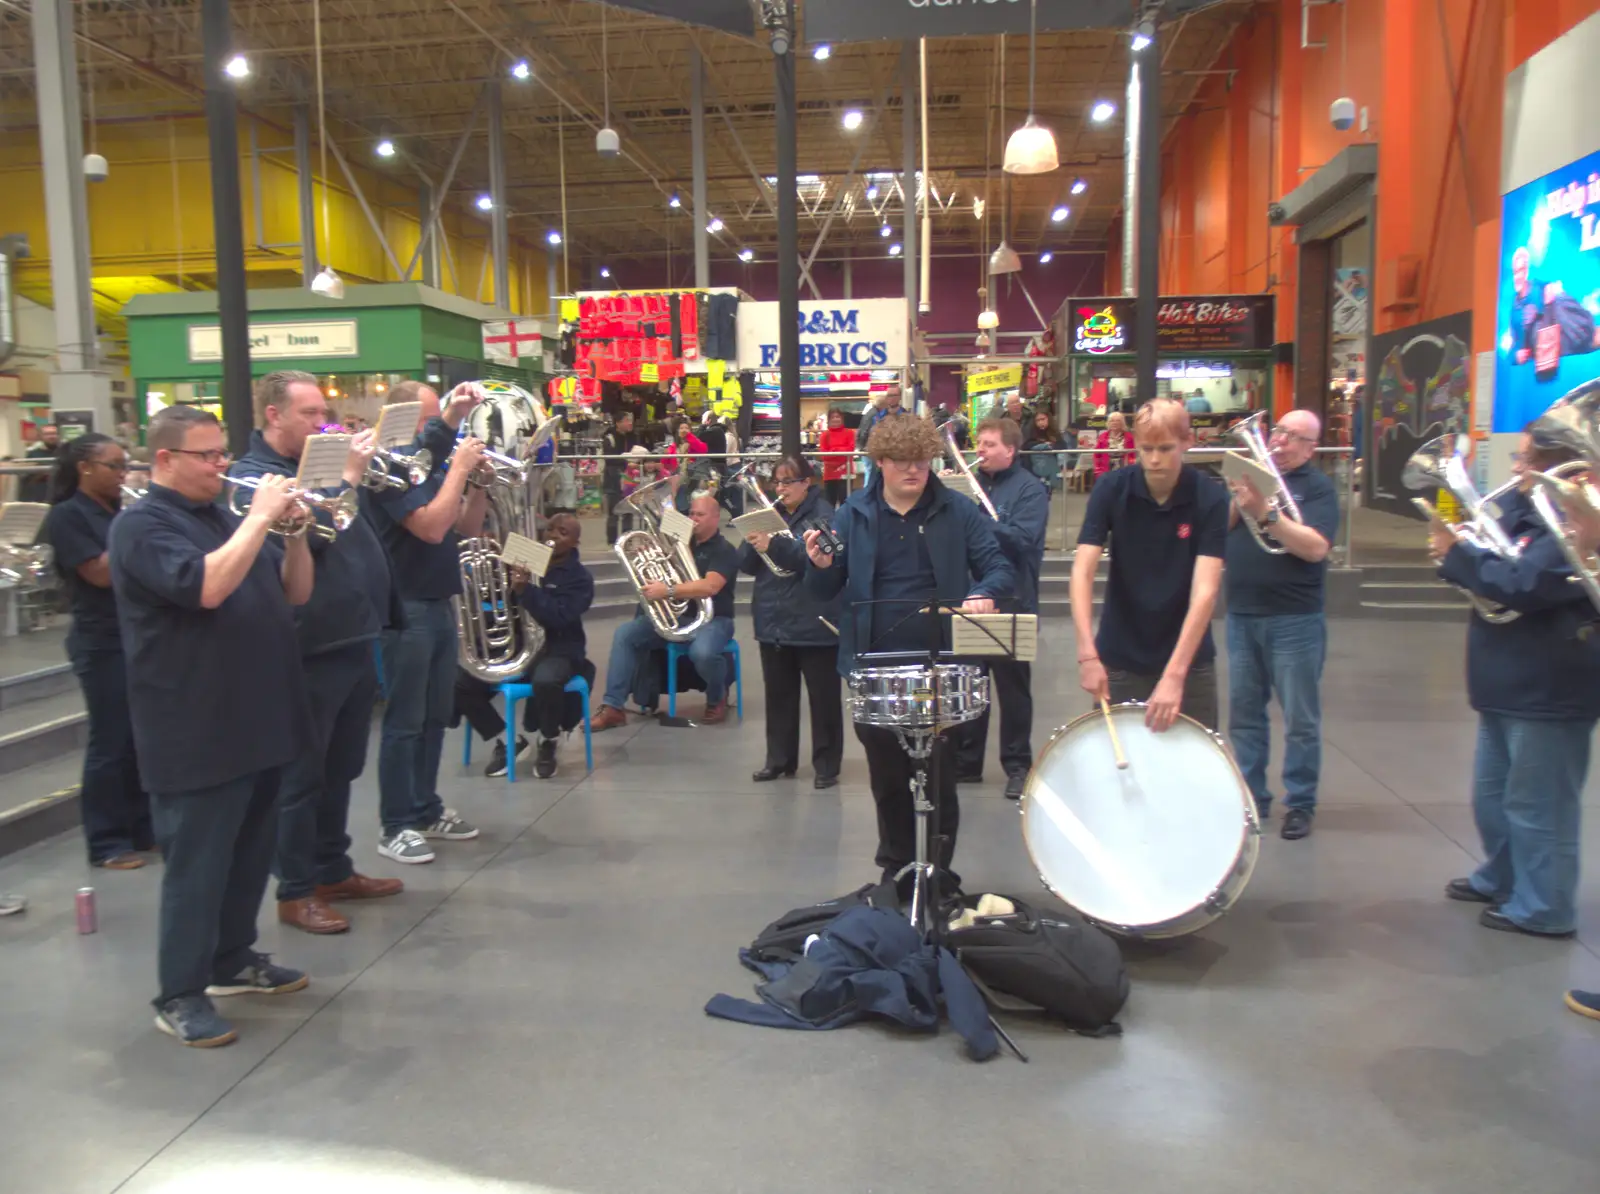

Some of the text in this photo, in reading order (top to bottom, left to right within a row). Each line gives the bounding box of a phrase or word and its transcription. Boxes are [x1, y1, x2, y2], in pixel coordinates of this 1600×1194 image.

[1157, 302, 1250, 325] Hot Bites
[760, 341, 887, 367] FBRICS
